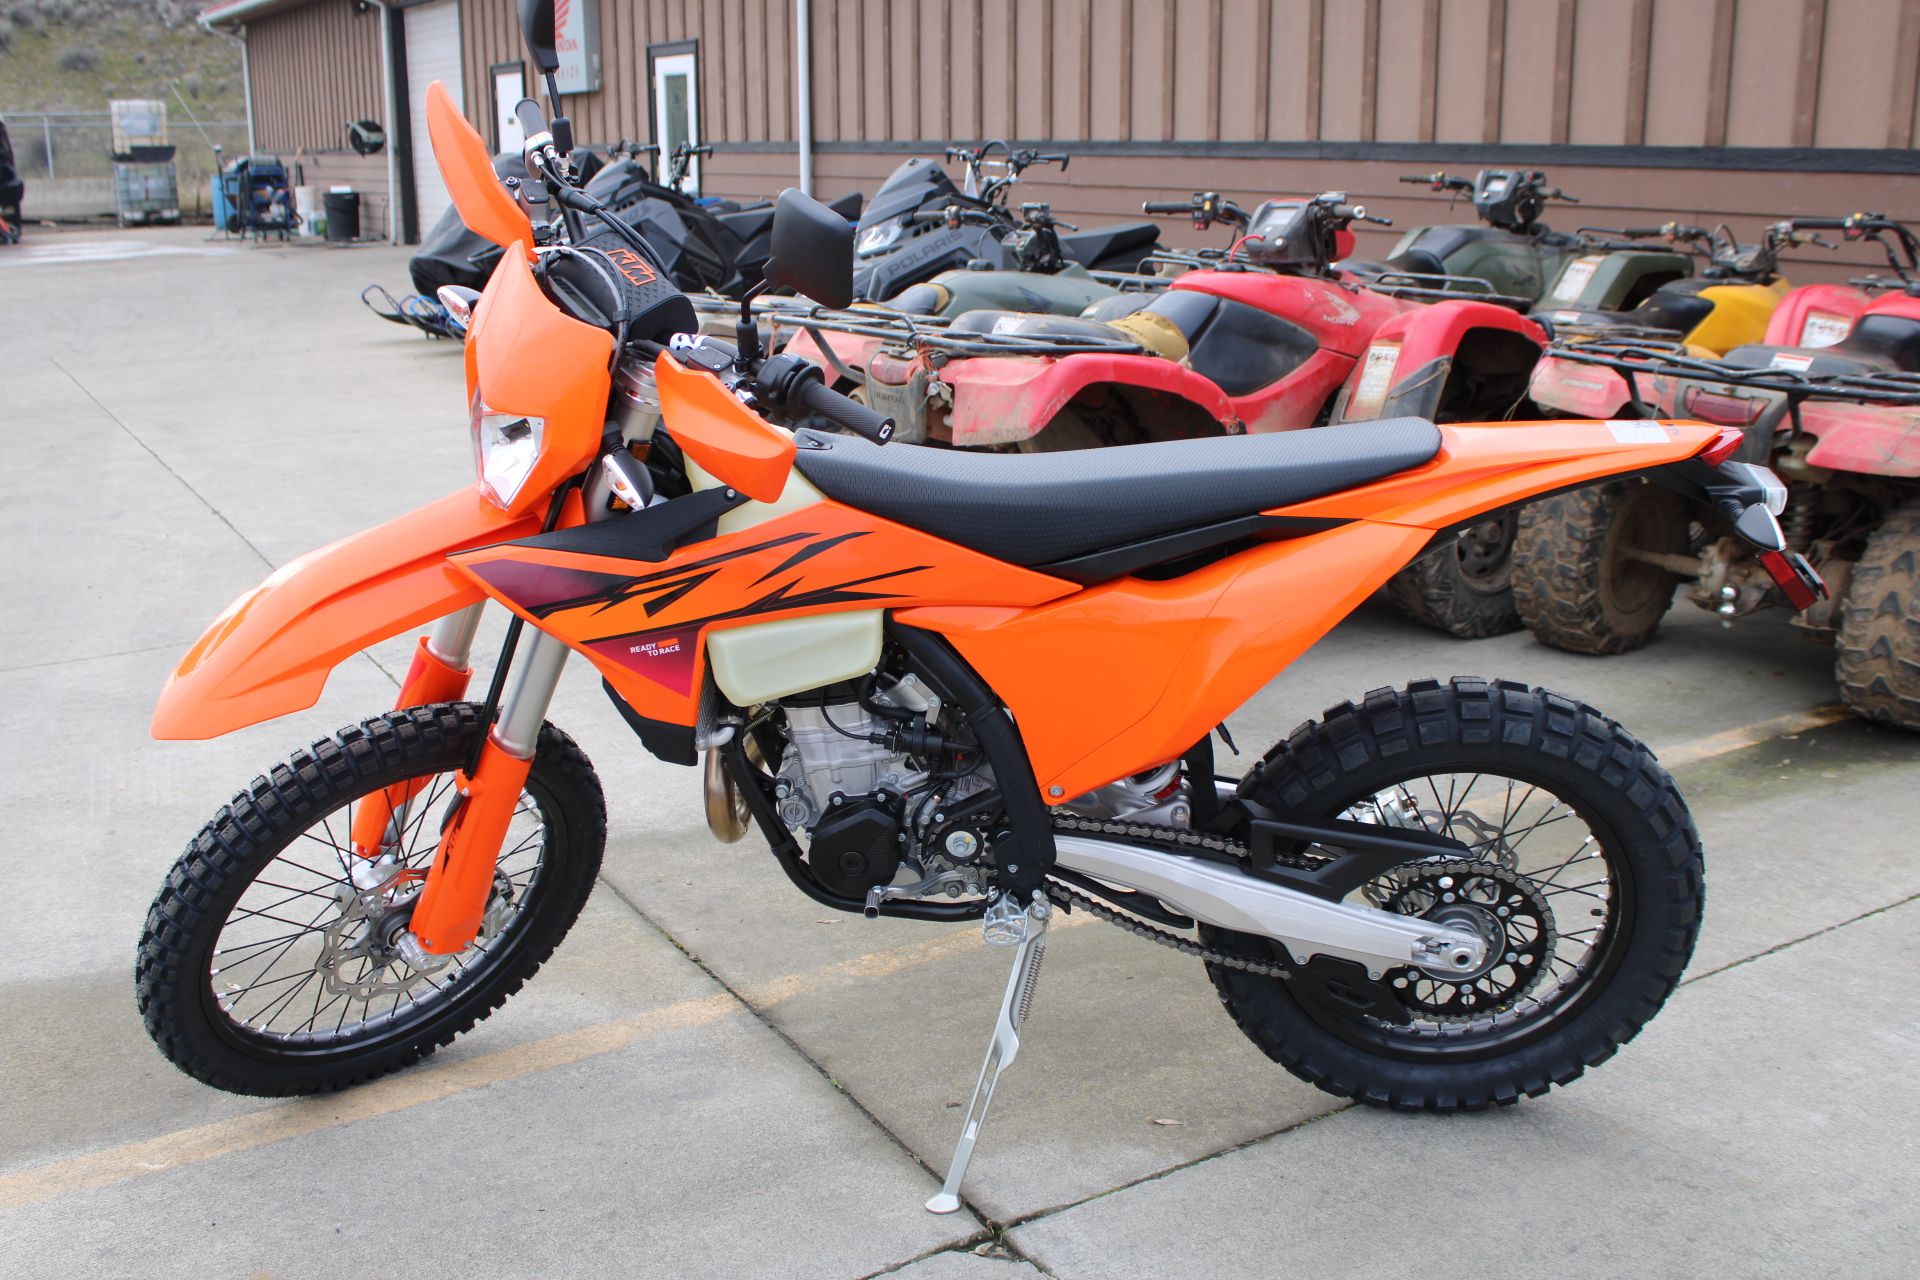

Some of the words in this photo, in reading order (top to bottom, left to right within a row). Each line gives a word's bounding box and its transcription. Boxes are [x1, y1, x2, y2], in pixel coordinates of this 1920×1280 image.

[887, 230, 964, 276] POLARIS
[605, 248, 656, 287] KTM
[630, 642, 657, 654] READY
[659, 644, 681, 655] RACE
